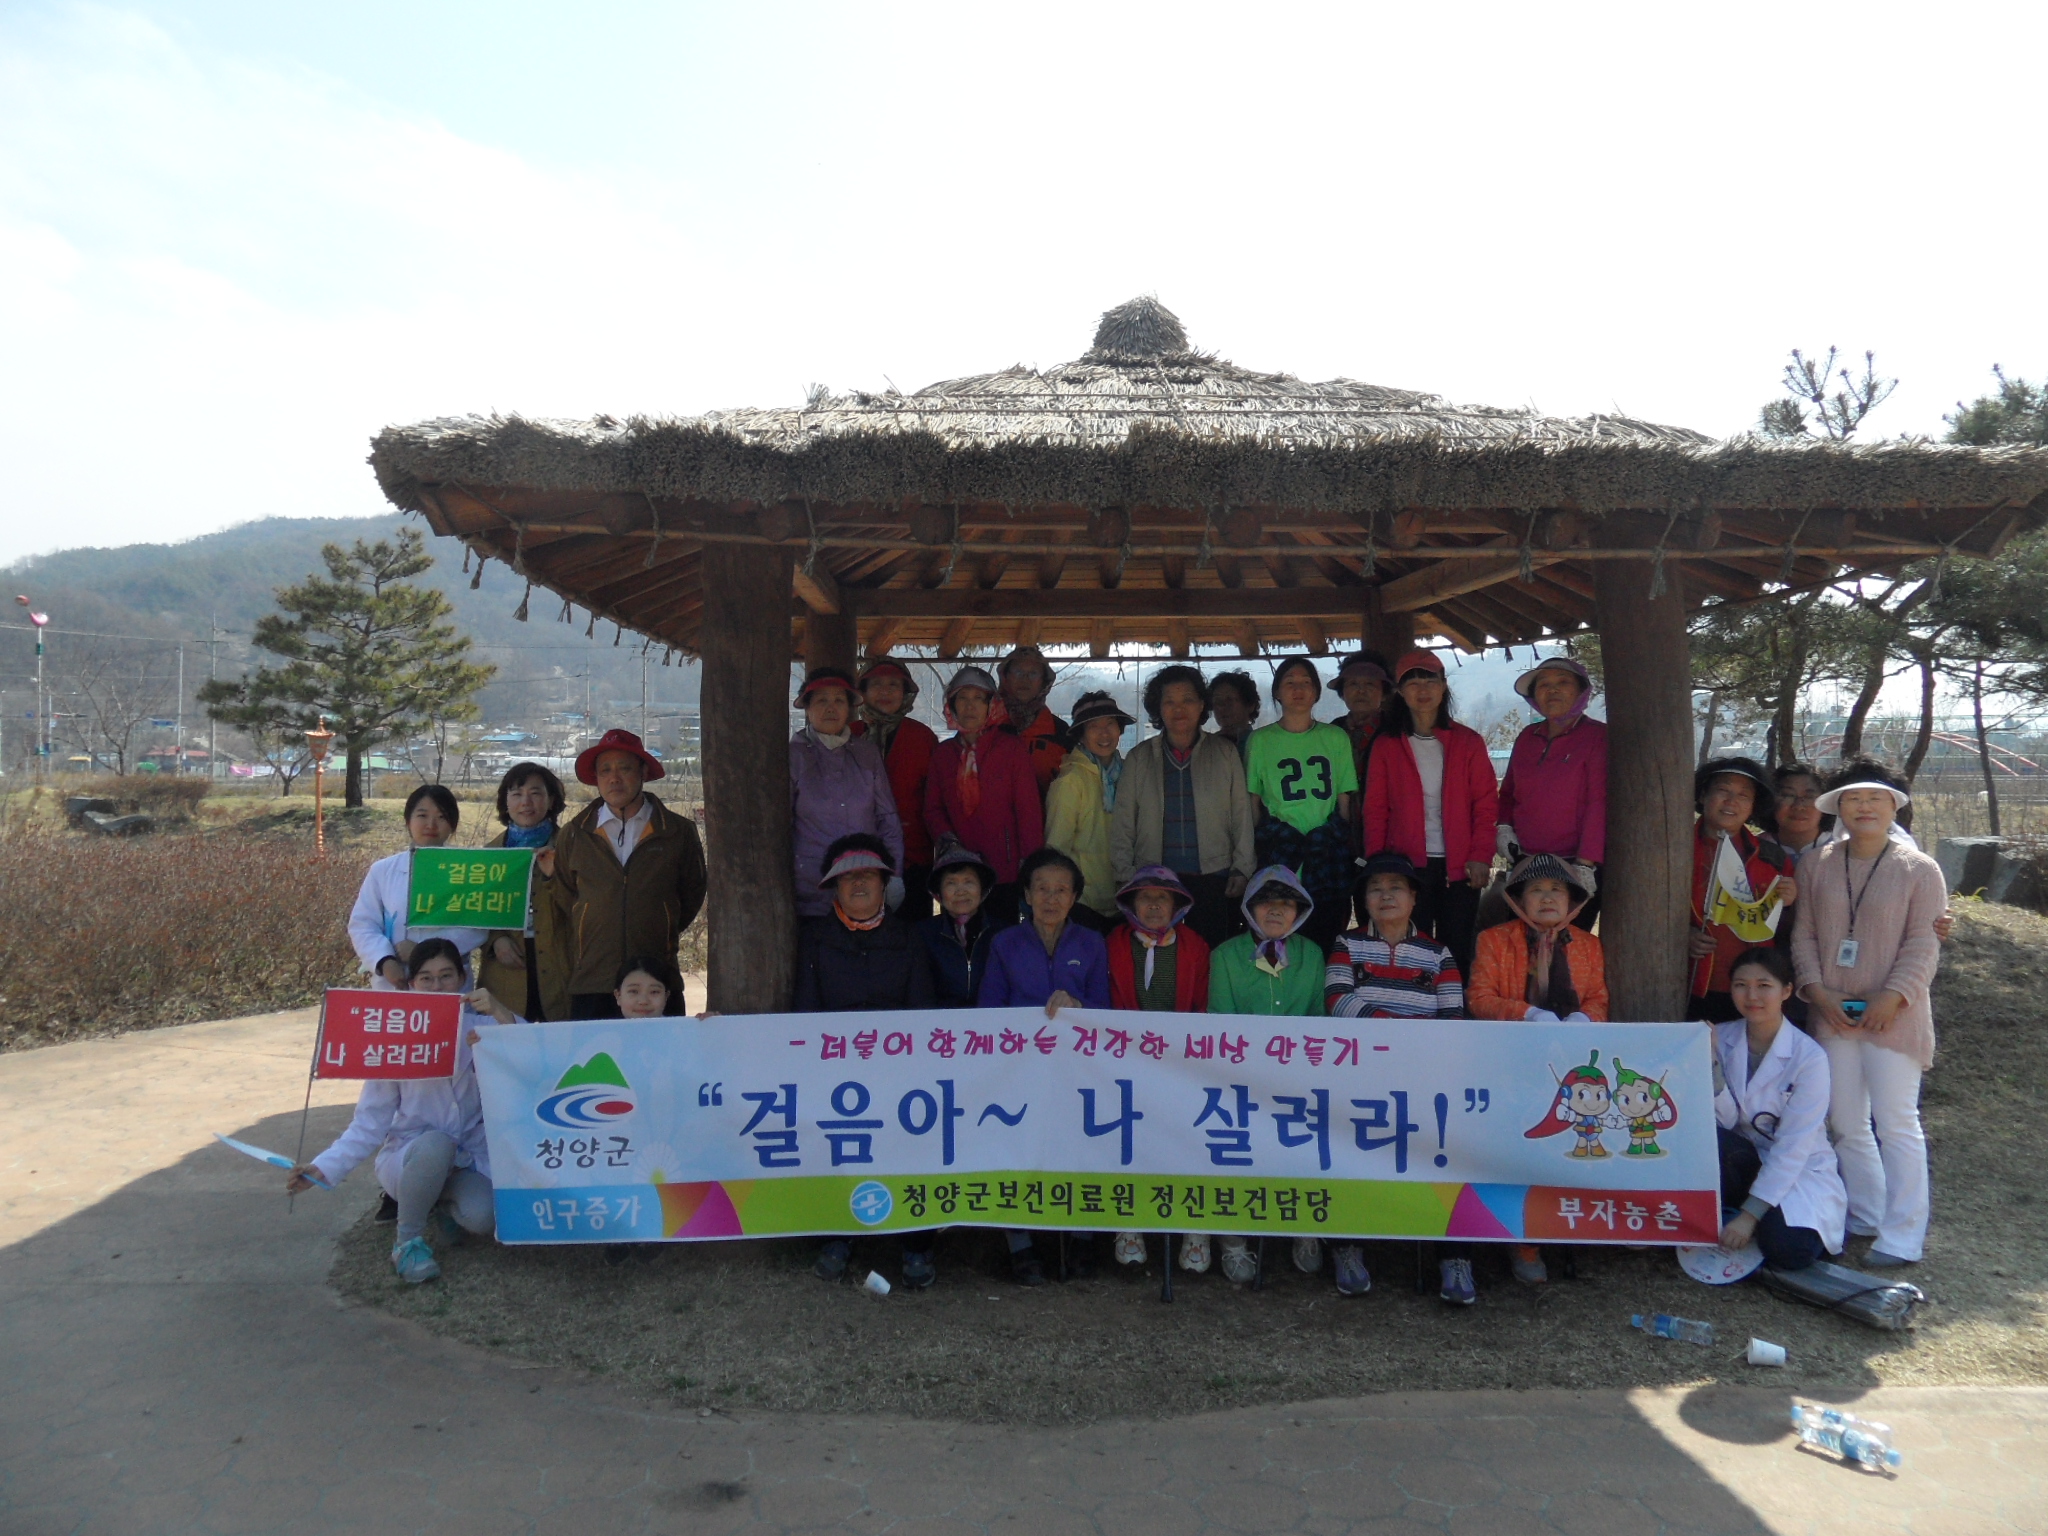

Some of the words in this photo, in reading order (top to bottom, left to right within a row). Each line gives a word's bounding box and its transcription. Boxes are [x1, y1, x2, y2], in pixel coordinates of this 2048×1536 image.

[1277, 755, 1333, 801] 23
[415, 893, 434, 914] 나
[325, 1042, 347, 1067] 나
[927, 1025, 1057, 1058] 함께하는
[1072, 1025, 1169, 1060] 건강한
[1184, 1032, 1250, 1064] 세상
[1077, 1079, 1144, 1165] 나
[536, 1136, 636, 1169] 청양군
[532, 1195, 642, 1230] 인구증가
[903, 1181, 1136, 1217] 청양군보건의료원
[1150, 1183, 1332, 1223] 정신보건담당
[1557, 1197, 1682, 1230] 부자농촌
